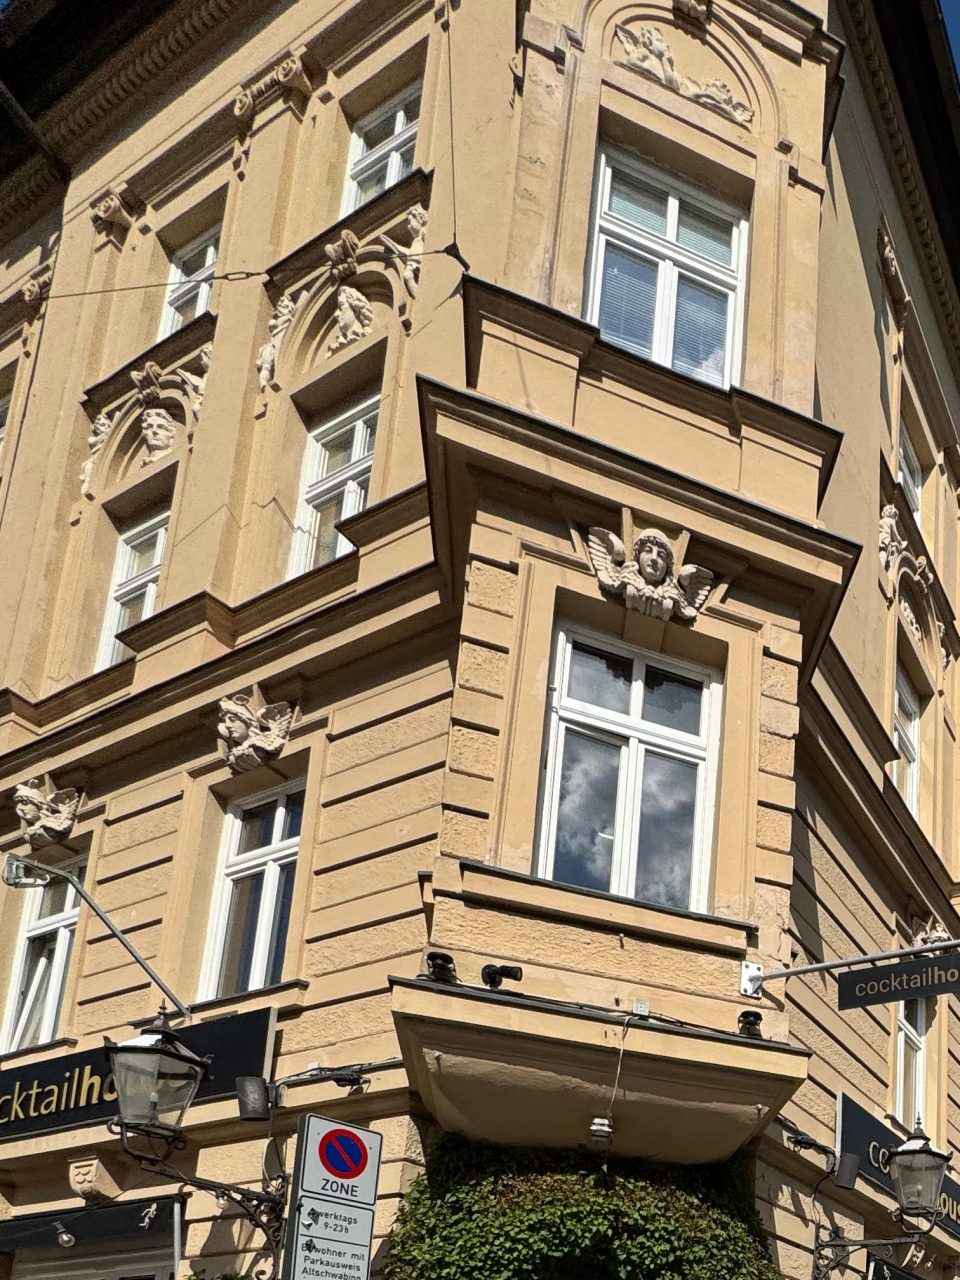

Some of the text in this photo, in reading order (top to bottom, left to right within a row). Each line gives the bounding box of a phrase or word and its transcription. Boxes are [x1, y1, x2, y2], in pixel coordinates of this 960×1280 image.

[321, 1178, 359, 1197] ZONE
[318, 1211, 358, 1225] werktags
[301, 1243, 365, 1261] Bwohner mit
[304, 1255, 360, 1271] Parkausweis
